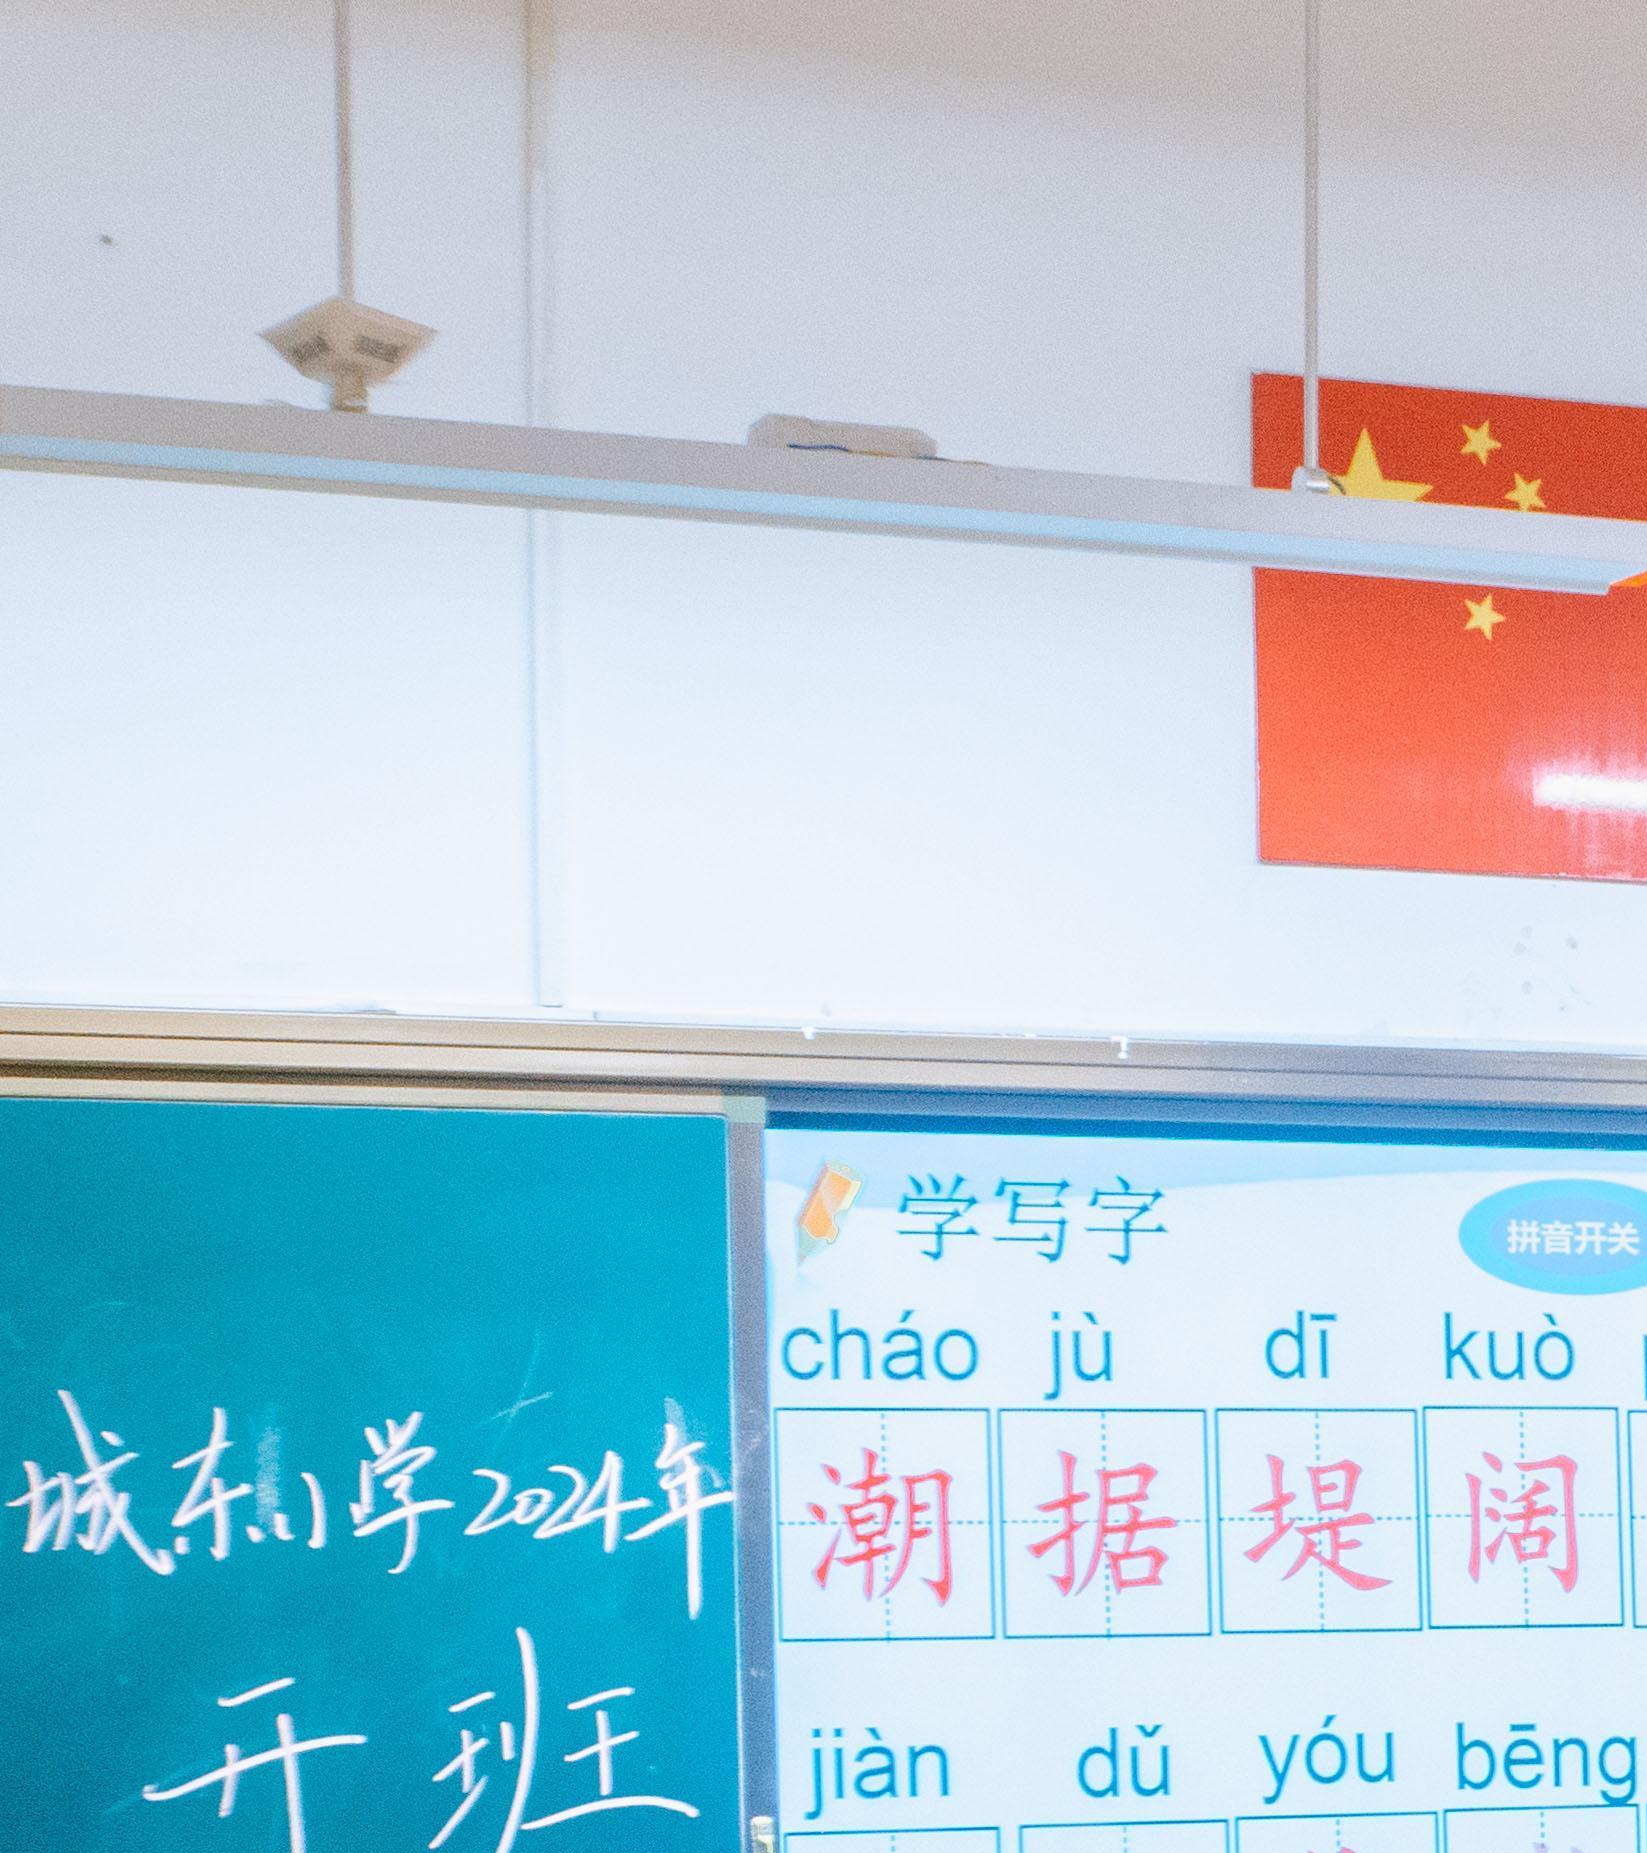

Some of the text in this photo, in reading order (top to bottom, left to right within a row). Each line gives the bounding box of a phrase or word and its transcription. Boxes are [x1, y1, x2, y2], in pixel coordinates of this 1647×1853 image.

[895, 1174, 1169, 1264] 学写字
[1506, 1219, 1640, 1255] 拼音开关
[781, 1309, 980, 1382] cháo
[1043, 1311, 1114, 1400] jù
[1265, 1311, 1337, 1380] dī
[1444, 1312, 1576, 1381] kuò
[809, 1447, 953, 1607] 潮
[1028, 1449, 1178, 1598] 据
[1244, 1453, 1393, 1591] 堤
[1463, 1451, 1579, 1594] 阔
[804, 1725, 951, 1819] jiàn
[1077, 1725, 1171, 1798] dǔ
[1258, 1714, 1396, 1805] yóu
[1455, 1721, 1638, 1806] bēng
